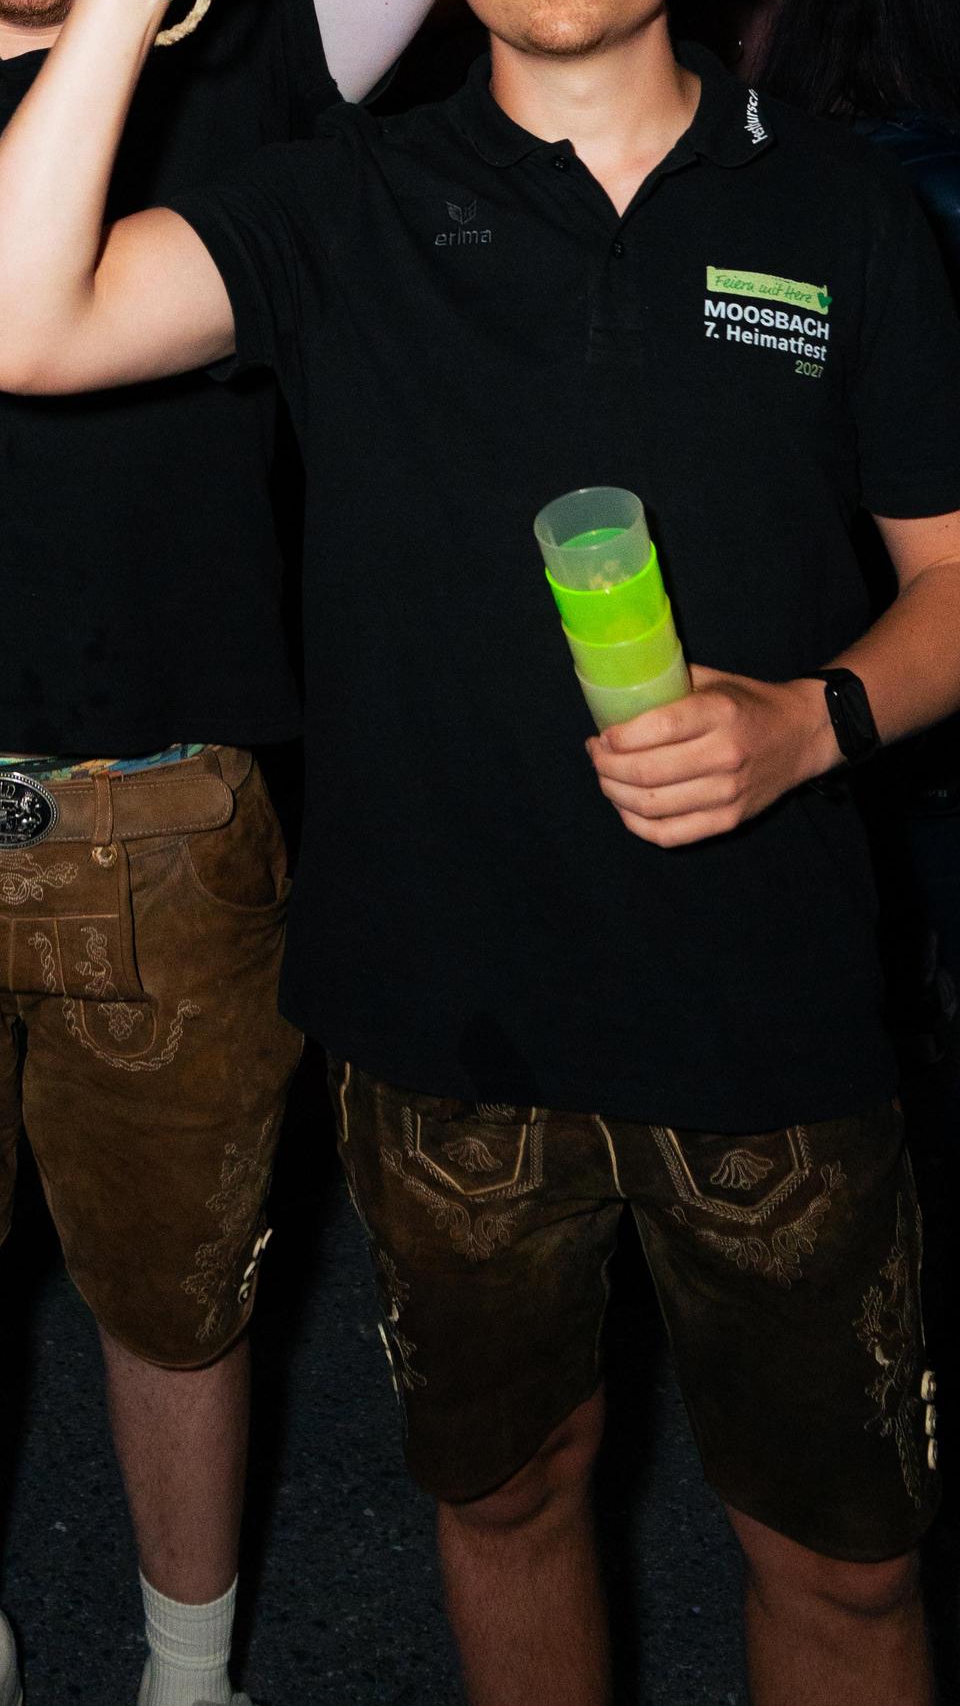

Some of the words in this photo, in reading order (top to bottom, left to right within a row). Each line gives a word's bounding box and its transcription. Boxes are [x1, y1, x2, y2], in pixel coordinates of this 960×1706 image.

[434, 226, 492, 247] erima
[714, 275, 754, 293] Feiern
[704, 299, 830, 341] MOOSBACH
[704, 321, 720, 339] 7.
[726, 324, 827, 362] Heimatfest
